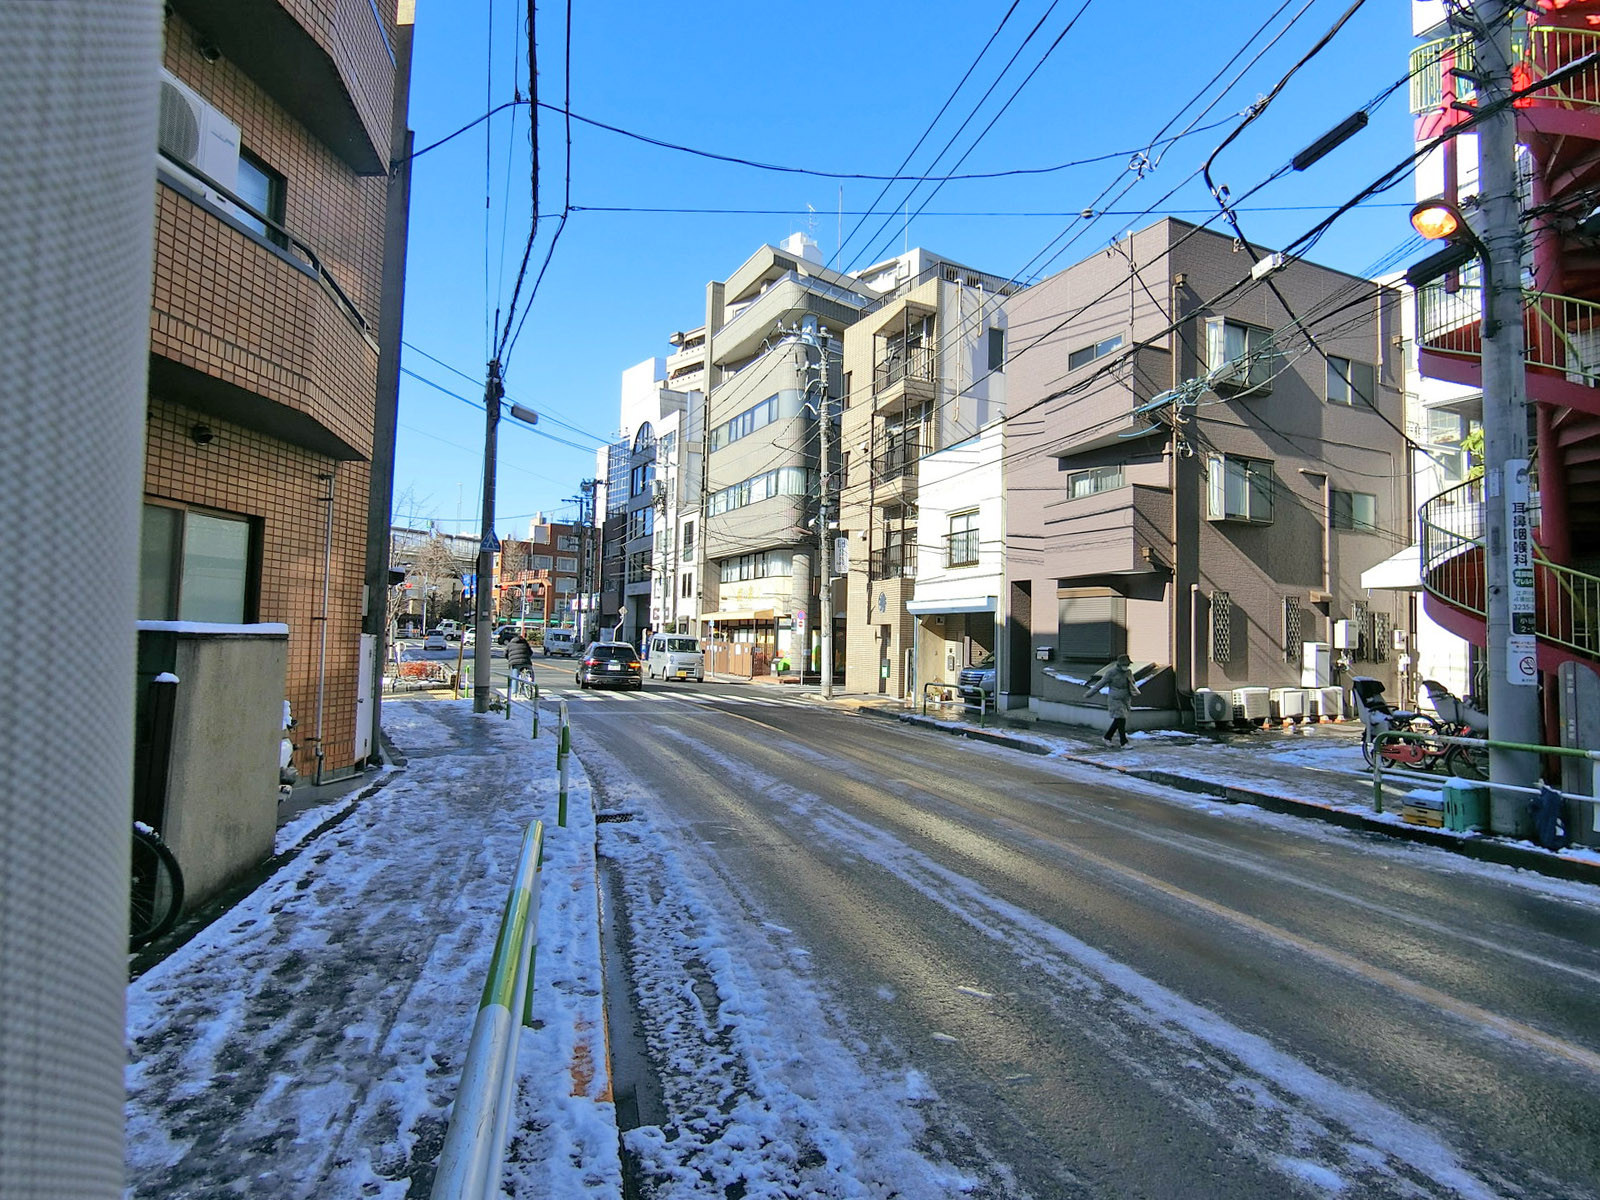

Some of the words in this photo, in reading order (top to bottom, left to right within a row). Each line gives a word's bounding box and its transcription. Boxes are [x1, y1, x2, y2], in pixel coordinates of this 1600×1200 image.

[1512, 502, 1528, 566] 耳鼻咽喉科
